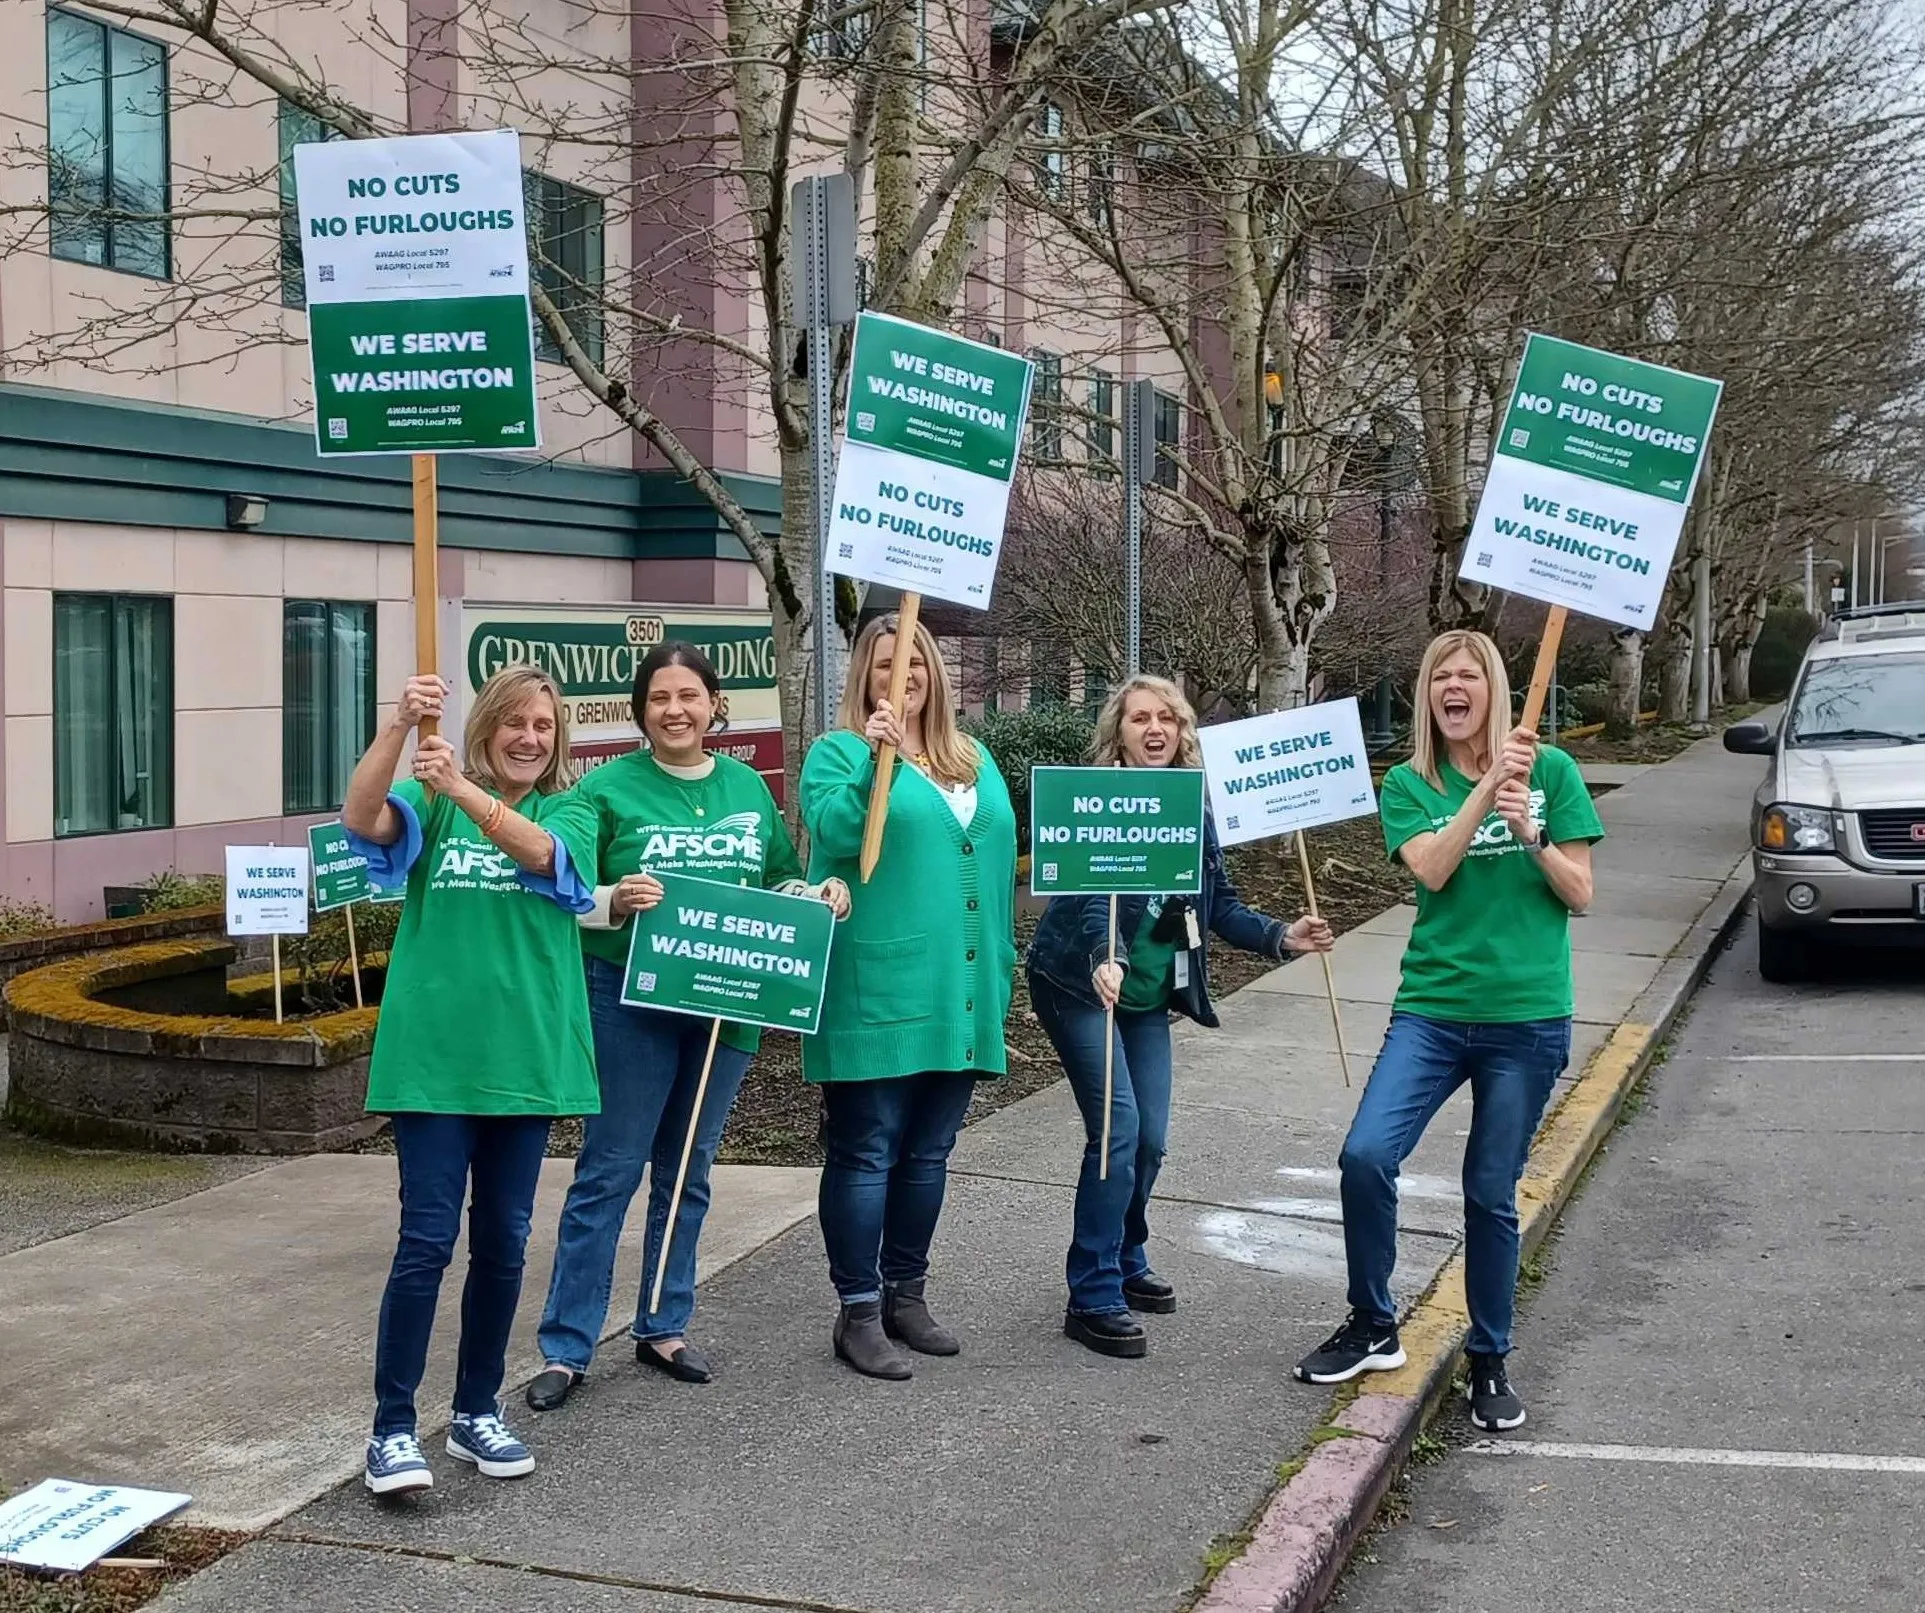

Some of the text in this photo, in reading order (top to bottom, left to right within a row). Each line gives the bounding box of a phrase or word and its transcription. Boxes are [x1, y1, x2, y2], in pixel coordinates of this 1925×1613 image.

[348, 173, 460, 198] NO CUTS
[311, 209, 514, 238] NO FURLOUGHS
[350, 331, 487, 356] WE SERVE
[331, 367, 513, 393] WASHINGTON
[891, 350, 995, 396] WE SERVE
[867, 376, 1006, 431] WASHINGTON
[1561, 372, 1664, 414] NO CUTS
[1516, 392, 1697, 455] NO FURLOUGHS
[878, 481, 964, 518] NO CUTS
[840, 503, 994, 557] NO FURLOUGHS
[1523, 493, 1638, 541] WE SERVE
[1494, 517, 1650, 576] WASHINGTON
[630, 620, 660, 642] 3501
[1235, 731, 1333, 764] WE SERVE
[1224, 754, 1355, 795] WASHINGTON
[1073, 796, 1162, 814] NO CUTS
[325, 841, 338, 854] NO
[640, 833, 762, 861] AFSCME
[1039, 826, 1197, 844] NO FURLOUGHS
[434, 849, 516, 878] AFSC
[656, 860, 684, 869] Make
[686, 859, 737, 869] Washington
[1467, 845, 1518, 856] Washington
[246, 867, 296, 879] WE SERVE
[316, 863, 329, 876] NO
[237, 888, 304, 899] WASHINGTON
[677, 907, 796, 944] WE SERVE
[651, 934, 811, 978] WASHINGTON
[87, 1489, 117, 1502] NO
[100, 1505, 131, 1517] NO
[60, 1517, 106, 1540] CUTS
